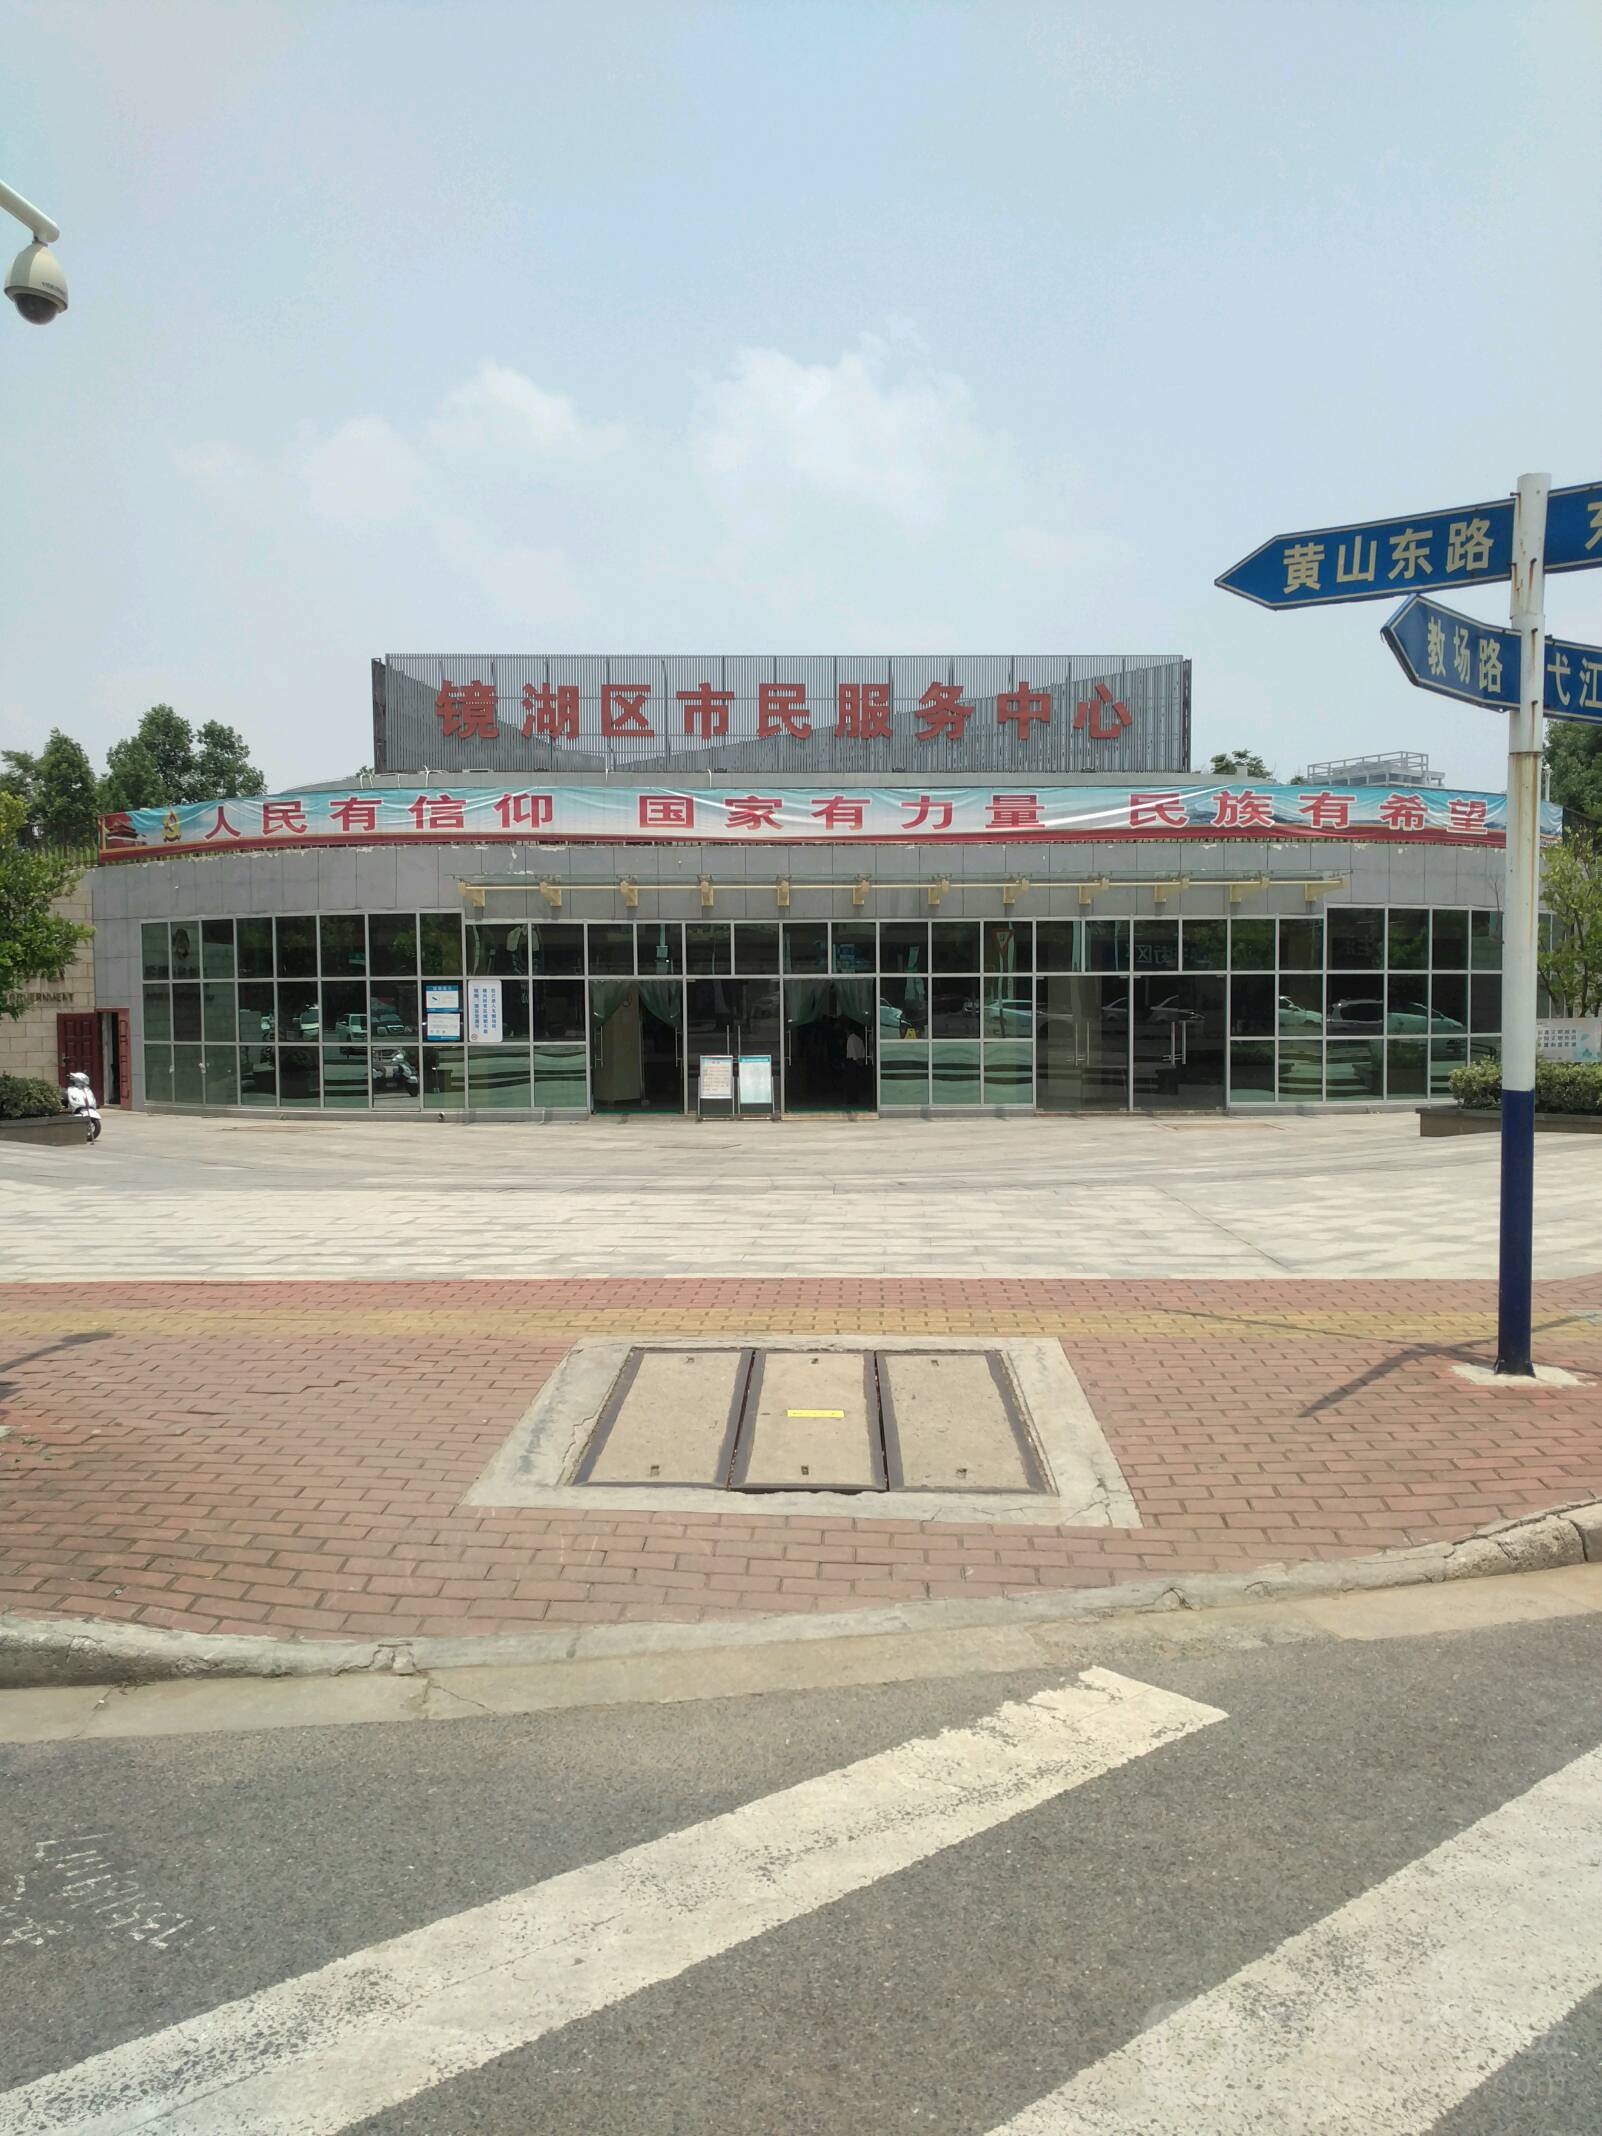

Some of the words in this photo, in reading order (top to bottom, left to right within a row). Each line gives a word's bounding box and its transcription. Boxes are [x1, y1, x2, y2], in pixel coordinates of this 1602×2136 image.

[1282, 518, 1495, 594] 黄山东路
[1427, 617, 1503, 694] 教场路
[436, 680, 1132, 742] 镜湖区市民服务中心
[204, 792, 554, 841] 人民有信仰
[638, 794, 1046, 831] 国家有力量
[1128, 790, 1489, 836] 民族有希望
